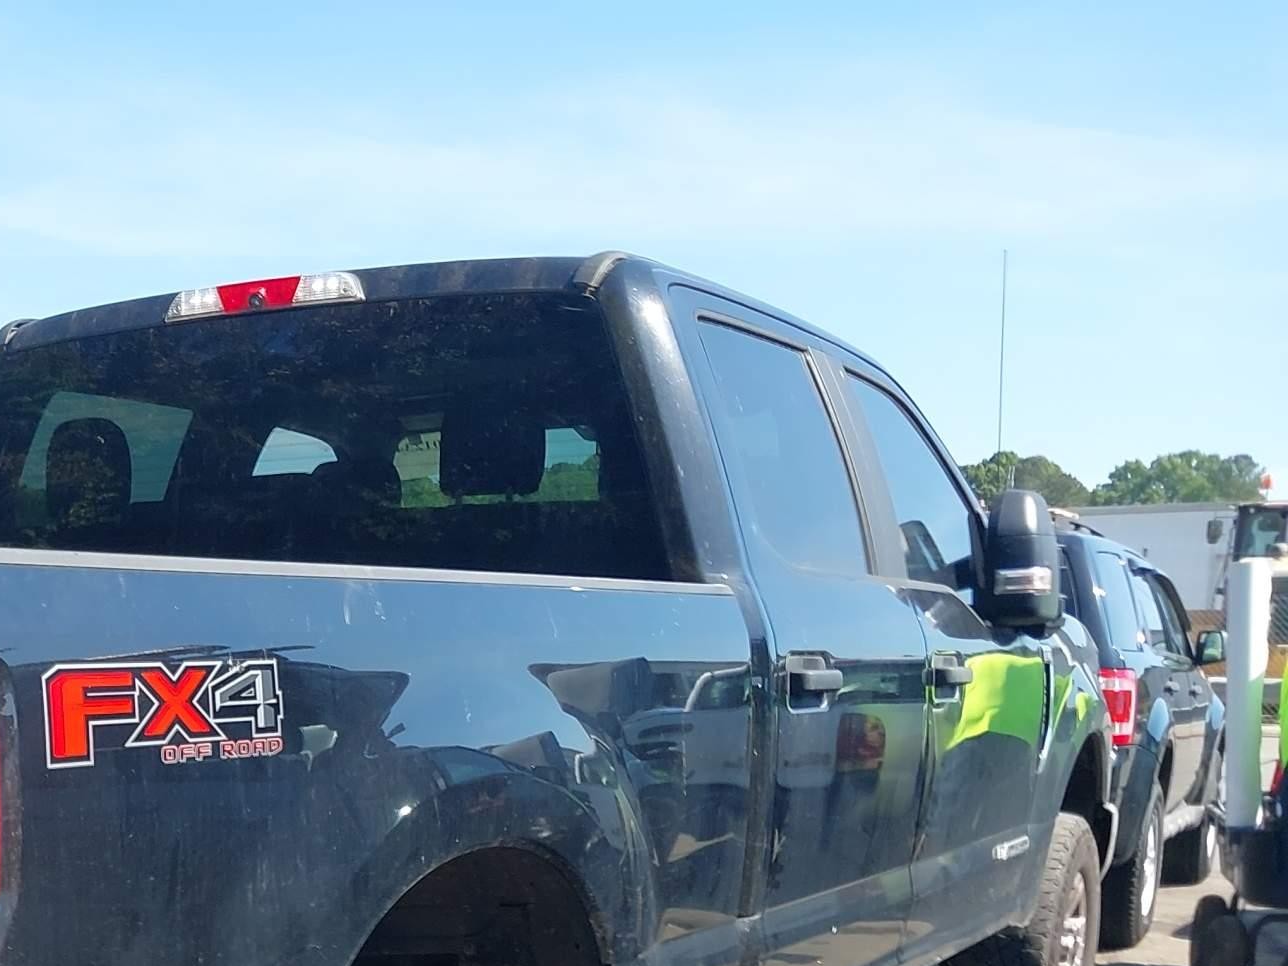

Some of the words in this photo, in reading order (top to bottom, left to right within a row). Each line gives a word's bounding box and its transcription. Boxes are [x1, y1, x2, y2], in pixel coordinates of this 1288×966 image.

[41, 659, 283, 769] FX4
[161, 743, 212, 765] OFF
[219, 737, 284, 760] ROAD
